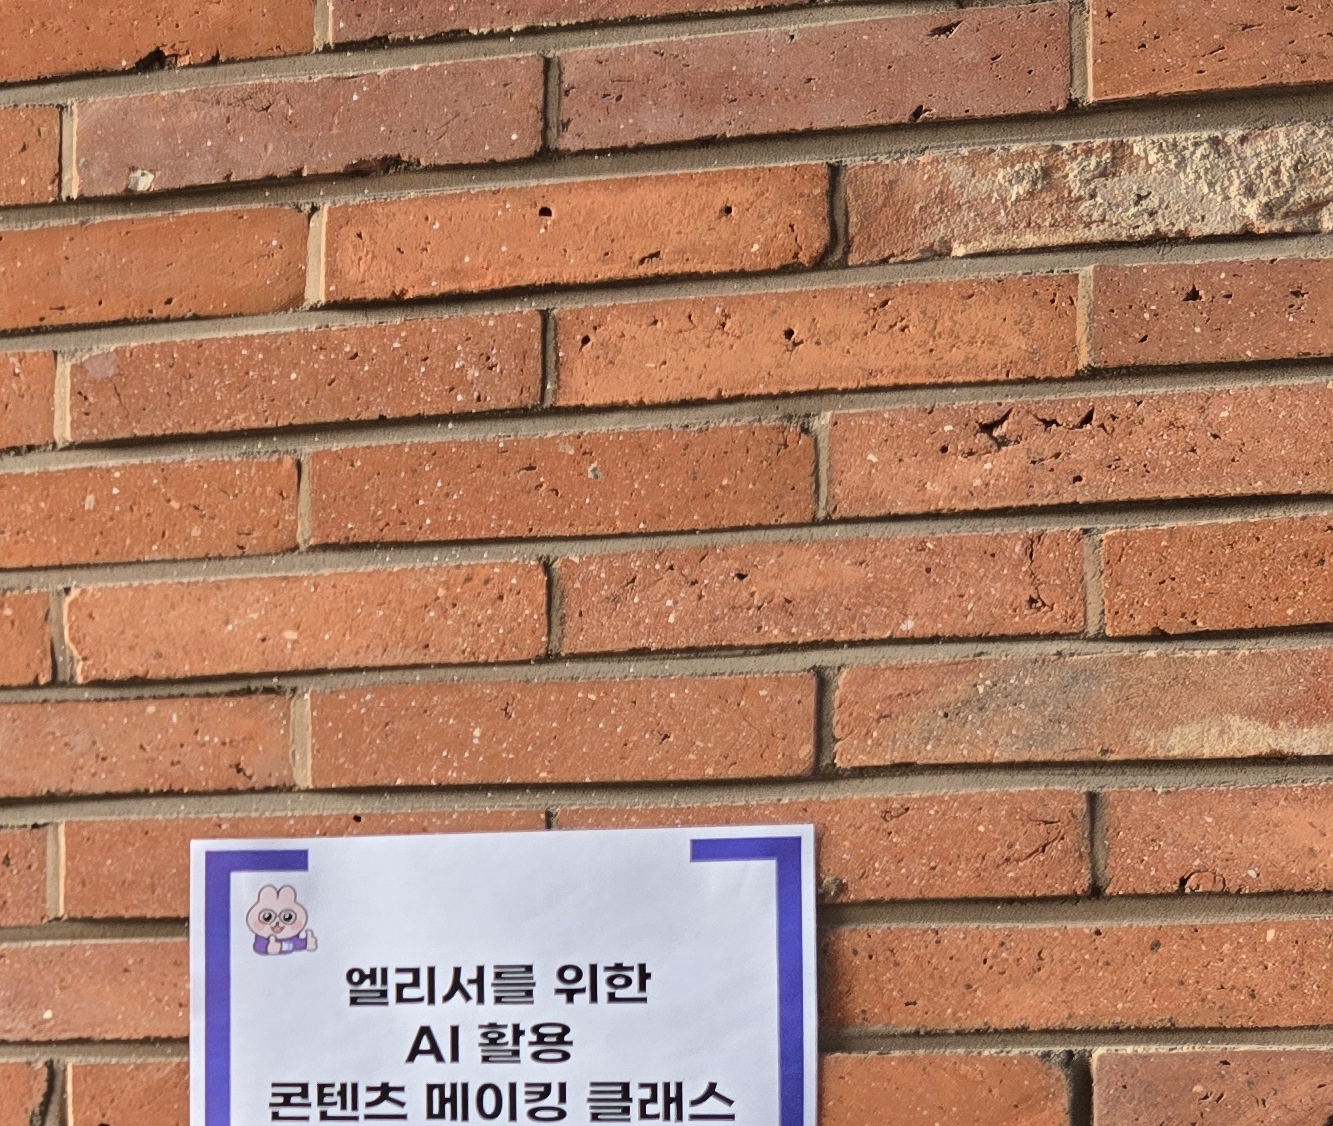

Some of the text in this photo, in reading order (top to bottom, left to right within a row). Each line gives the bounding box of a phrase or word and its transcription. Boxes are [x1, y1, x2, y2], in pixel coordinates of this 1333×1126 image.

[346, 963, 651, 1006] 엘리서를 위한
[406, 1023, 573, 1063] AI 활용
[269, 1082, 735, 1122] 콘텐츠 메이킹 클래스
